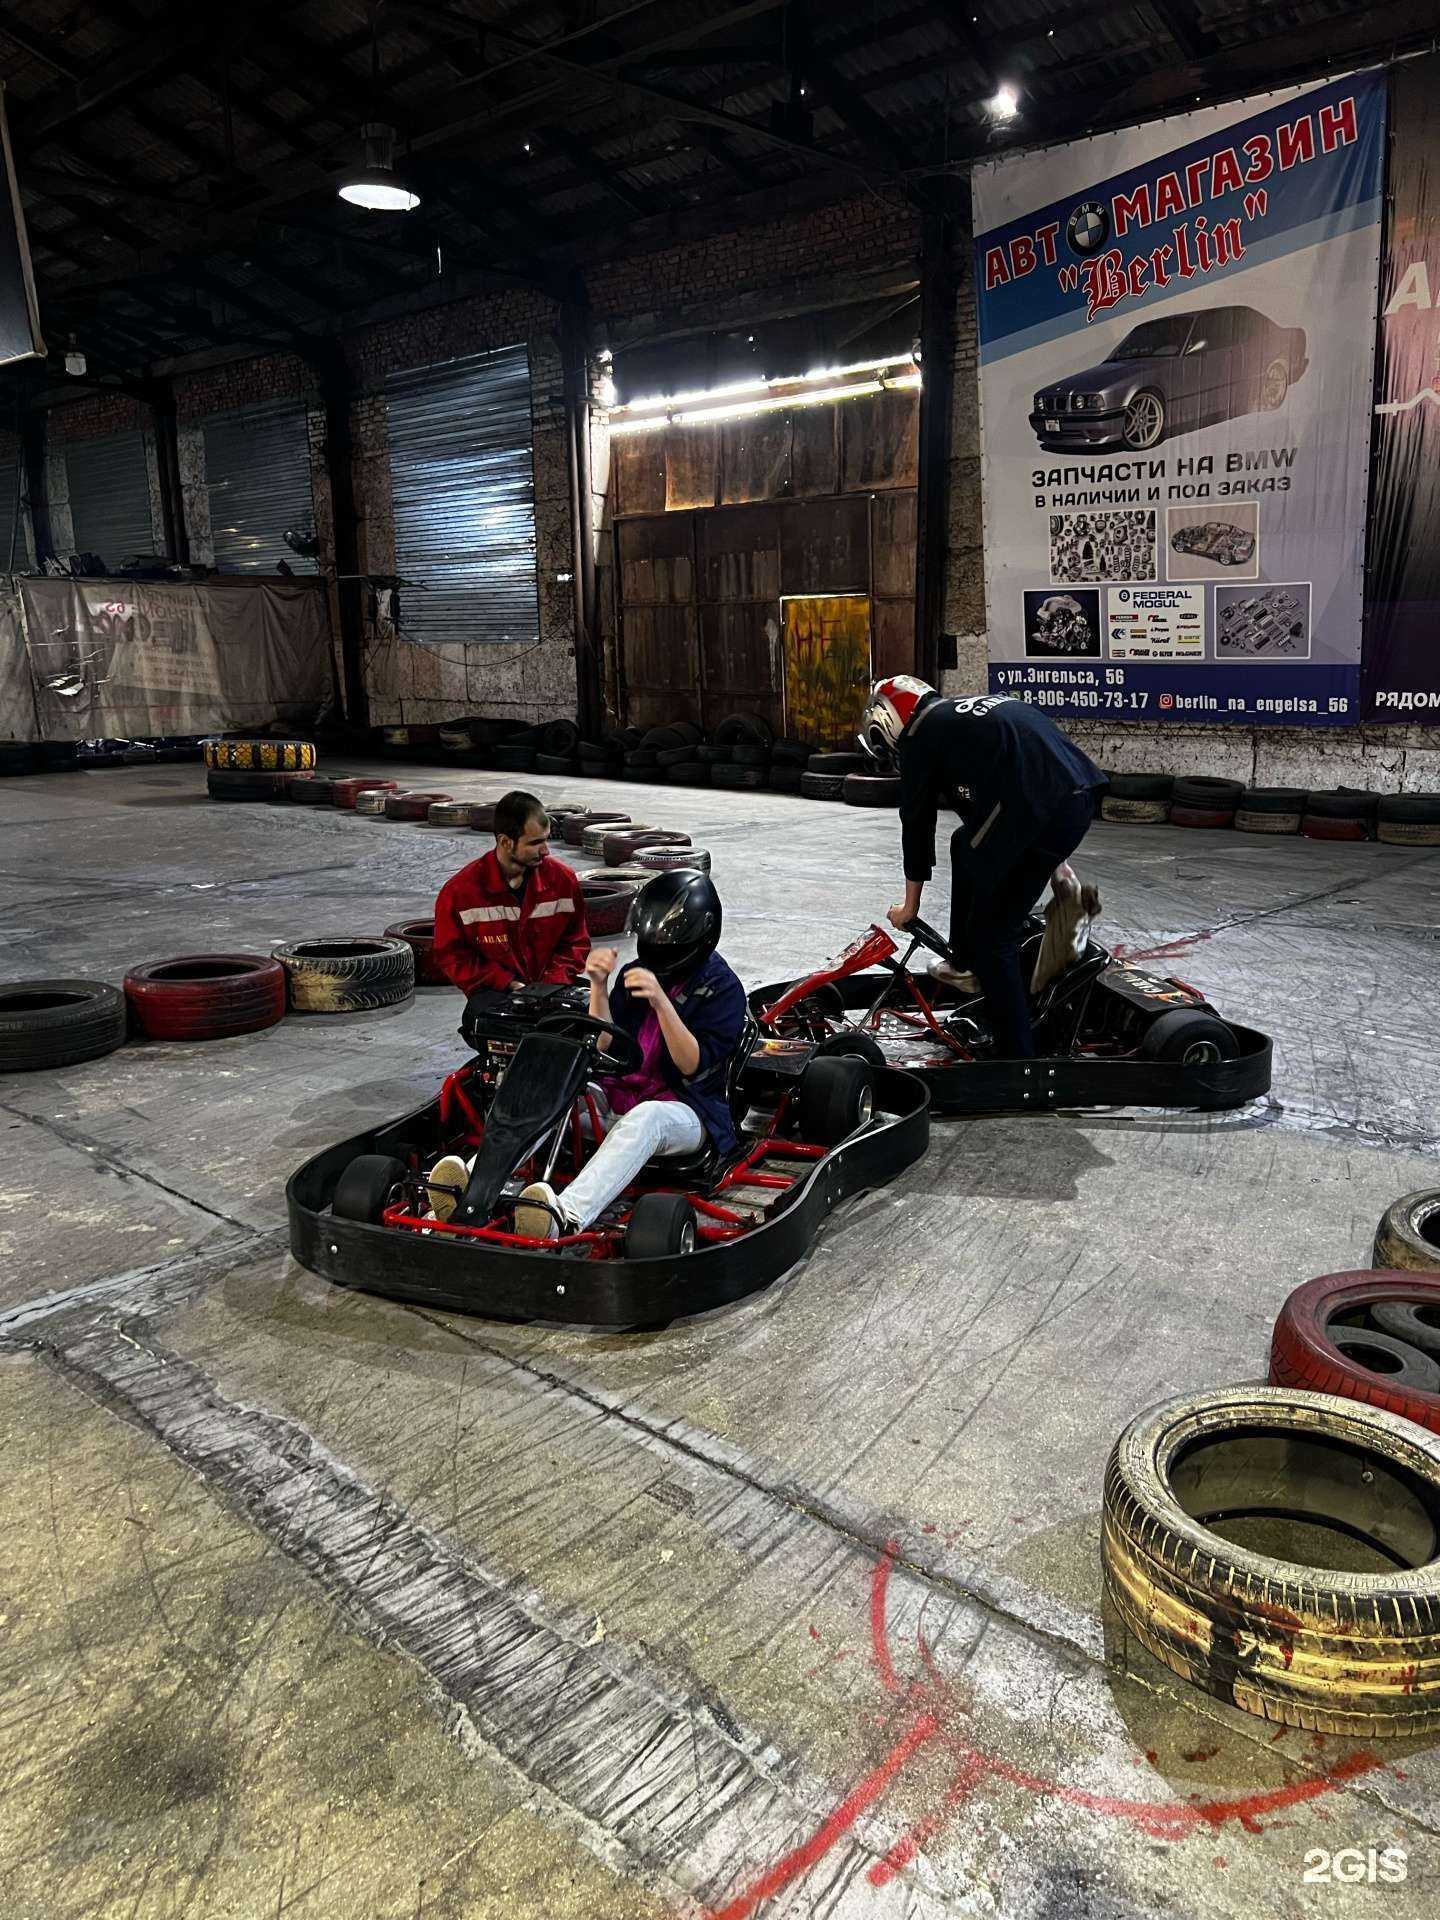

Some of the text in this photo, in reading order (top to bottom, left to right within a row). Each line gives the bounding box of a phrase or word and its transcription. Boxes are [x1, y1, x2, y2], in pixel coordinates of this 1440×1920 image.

[984, 96, 1359, 291] АВТ МАГАЗИН
[1031, 447, 1298, 488] ЗАПЧАСТИ НА BMW
[1035, 476, 1292, 508] В НАЛИЧИИ И ПОД ЗАКАЗ
[1133, 590, 1192, 600] FEDERAL
[1133, 600, 1180, 608] MOGUL
[1007, 667, 1125, 687] ул.Энгельса, 56
[1023, 690, 1149, 709] 8-906-450-73-17
[1175, 694, 1349, 715] berlin_na_engelsa_56
[1375, 691, 1440, 710] РЯДОМ
